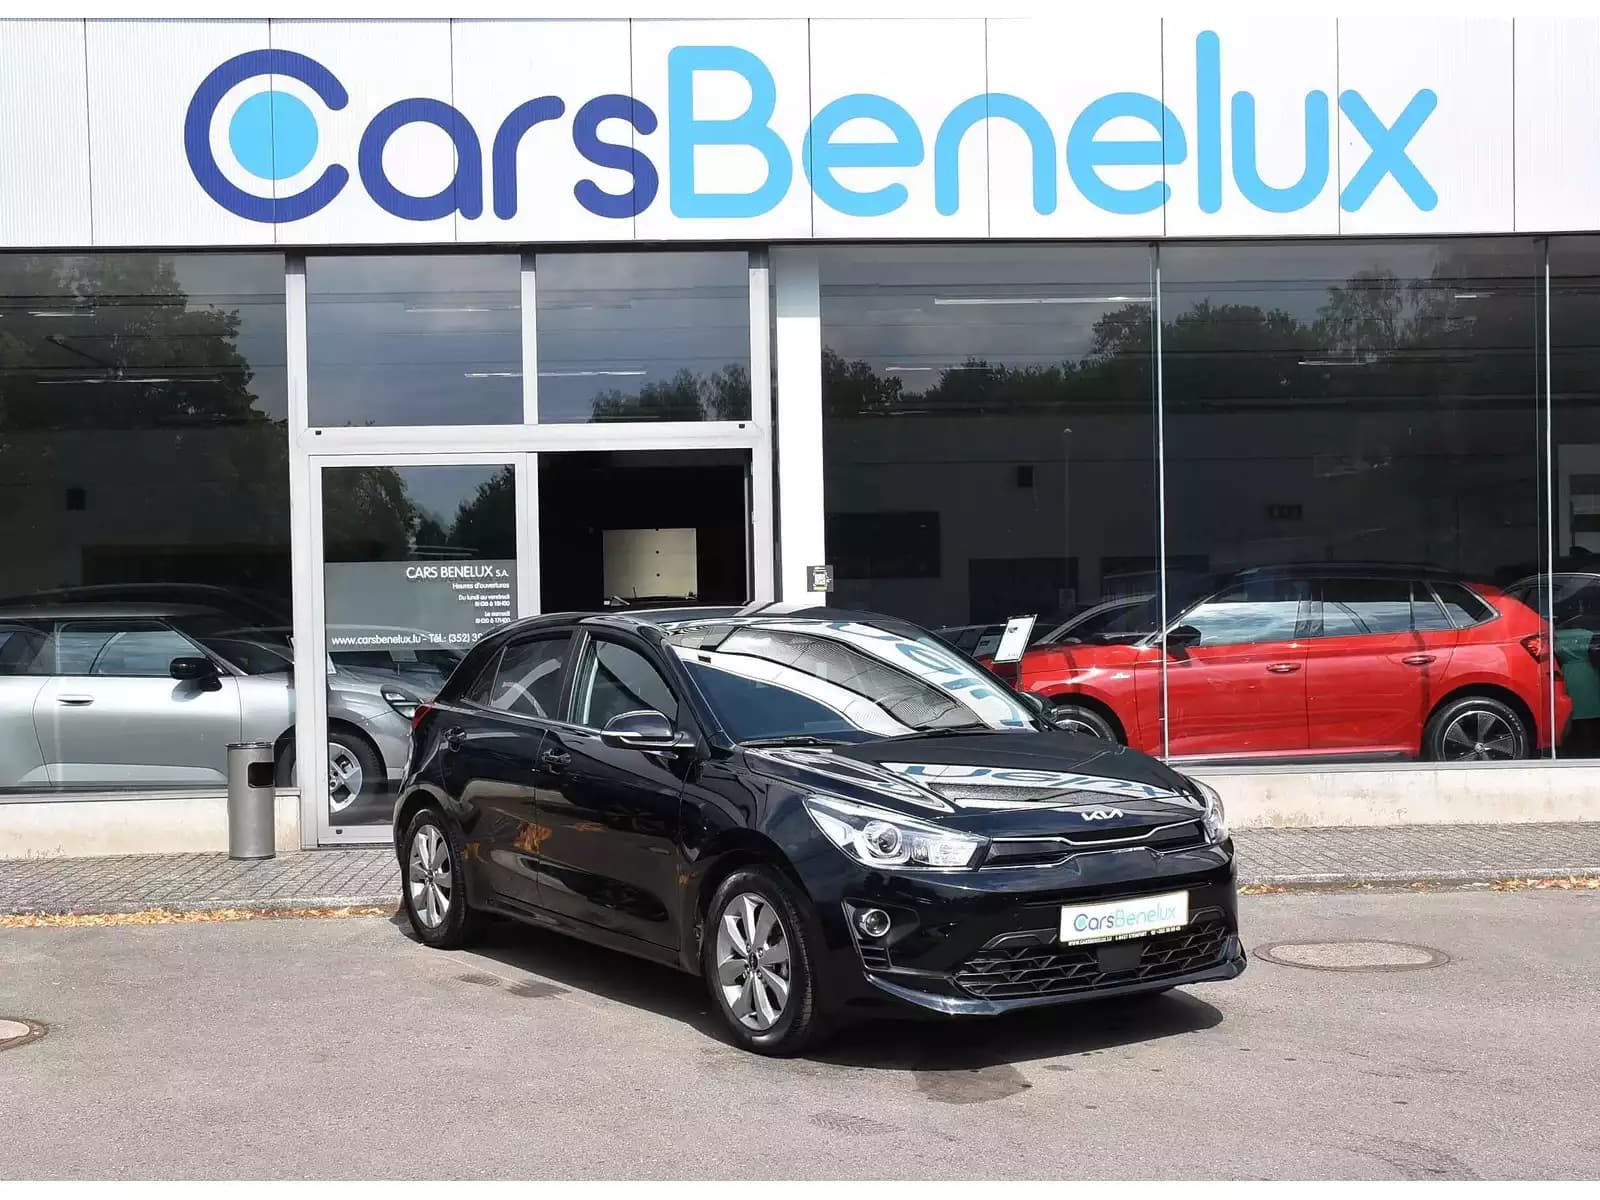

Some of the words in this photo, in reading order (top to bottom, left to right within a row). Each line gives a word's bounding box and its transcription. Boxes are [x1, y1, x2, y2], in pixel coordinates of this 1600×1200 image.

[406, 567, 438, 579] CARS
[440, 566, 493, 578] BENELUX
[331, 633, 421, 646] www.carsbenelux.lu
[448, 633, 471, 644] (352)
[1081, 809, 1123, 821] KIA
[1074, 902, 1176, 932] CarsBenelux
